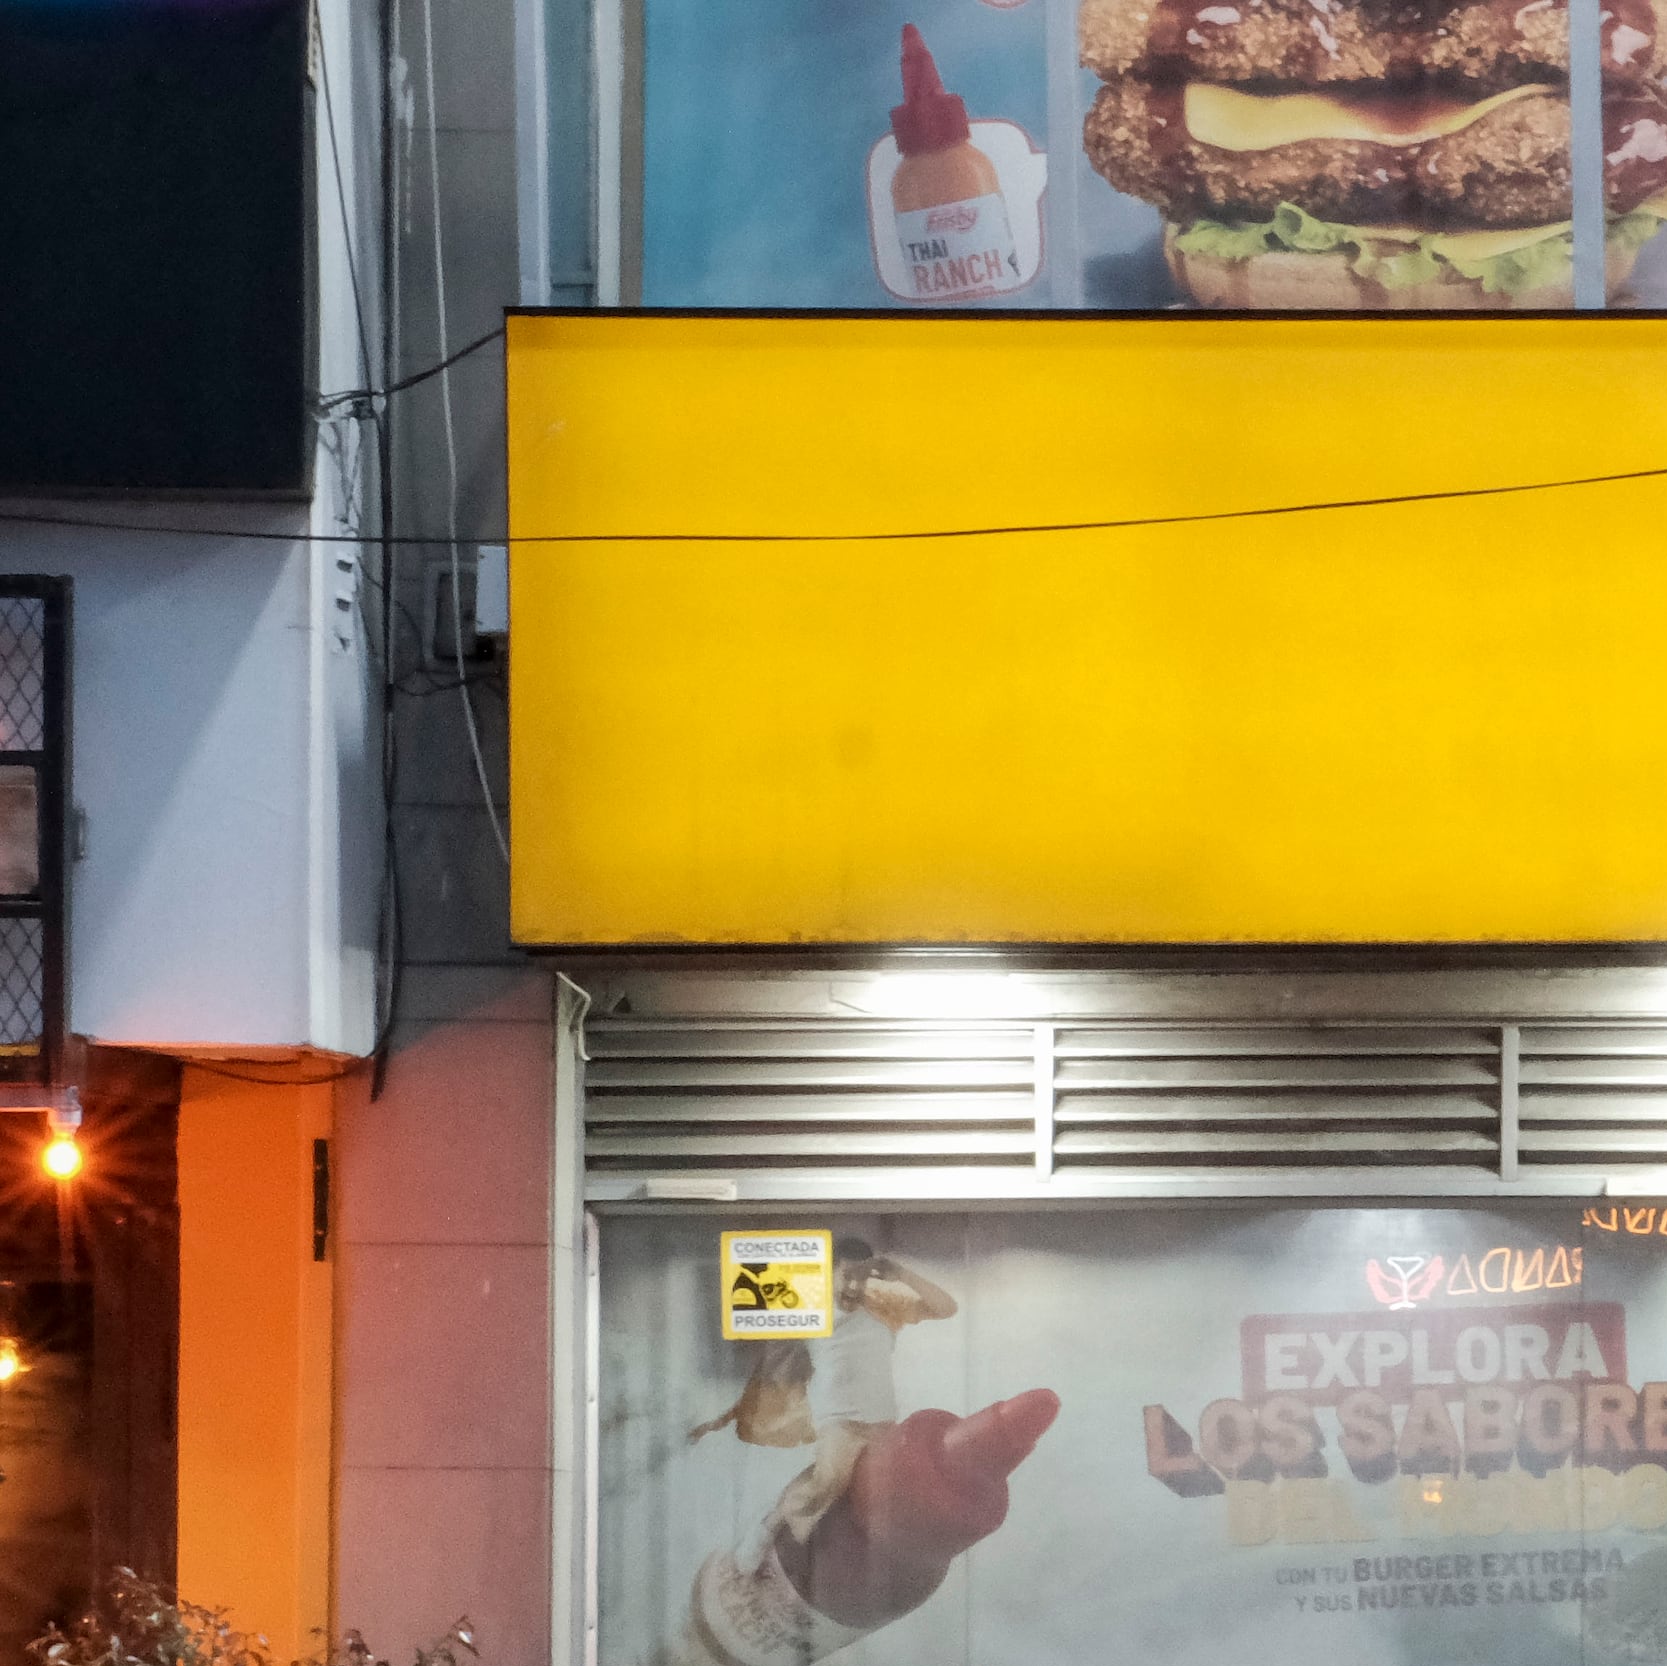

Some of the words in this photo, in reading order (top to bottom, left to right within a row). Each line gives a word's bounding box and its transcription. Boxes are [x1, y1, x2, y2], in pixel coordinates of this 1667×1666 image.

[907, 239, 949, 262] THAI
[912, 249, 1004, 294] RANCH
[734, 1241, 819, 1254] CONECTADA
[734, 1314, 820, 1328] PROSEGUR
[1264, 1321, 1609, 1393] EXPLORA
[1144, 1396, 1323, 1490] LOS
[1353, 1554, 1474, 1583] BURGER
[1480, 1548, 1624, 1578] EXTREMA
[1313, 1593, 1351, 1613] SUS
[1356, 1580, 1477, 1611] NUEVAS
[1486, 1576, 1608, 1605] SALSAS
